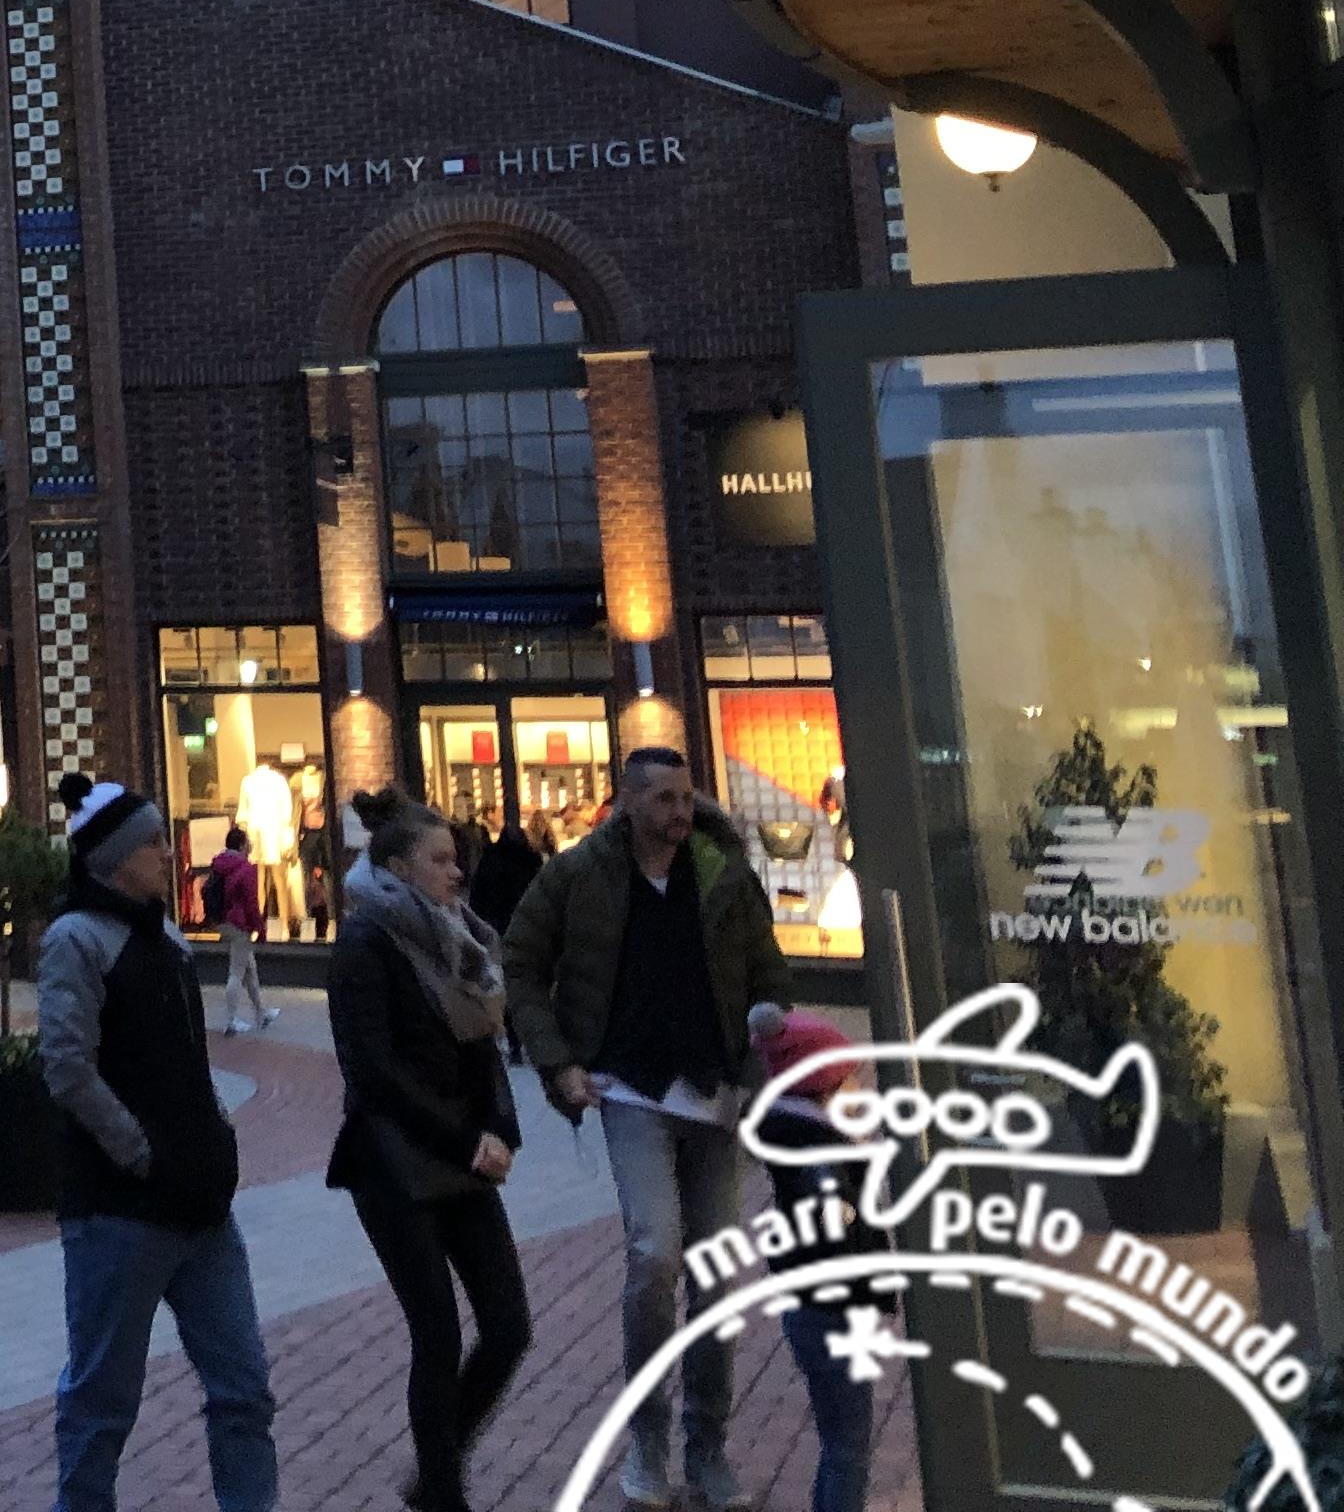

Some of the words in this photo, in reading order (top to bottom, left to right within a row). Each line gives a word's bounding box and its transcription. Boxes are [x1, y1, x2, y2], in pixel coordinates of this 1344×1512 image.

[253, 156, 425, 192] TOMMY
[498, 136, 686, 176] HILFIGER
[990, 911, 1072, 942] new
[1081, 908, 1257, 945] bala
